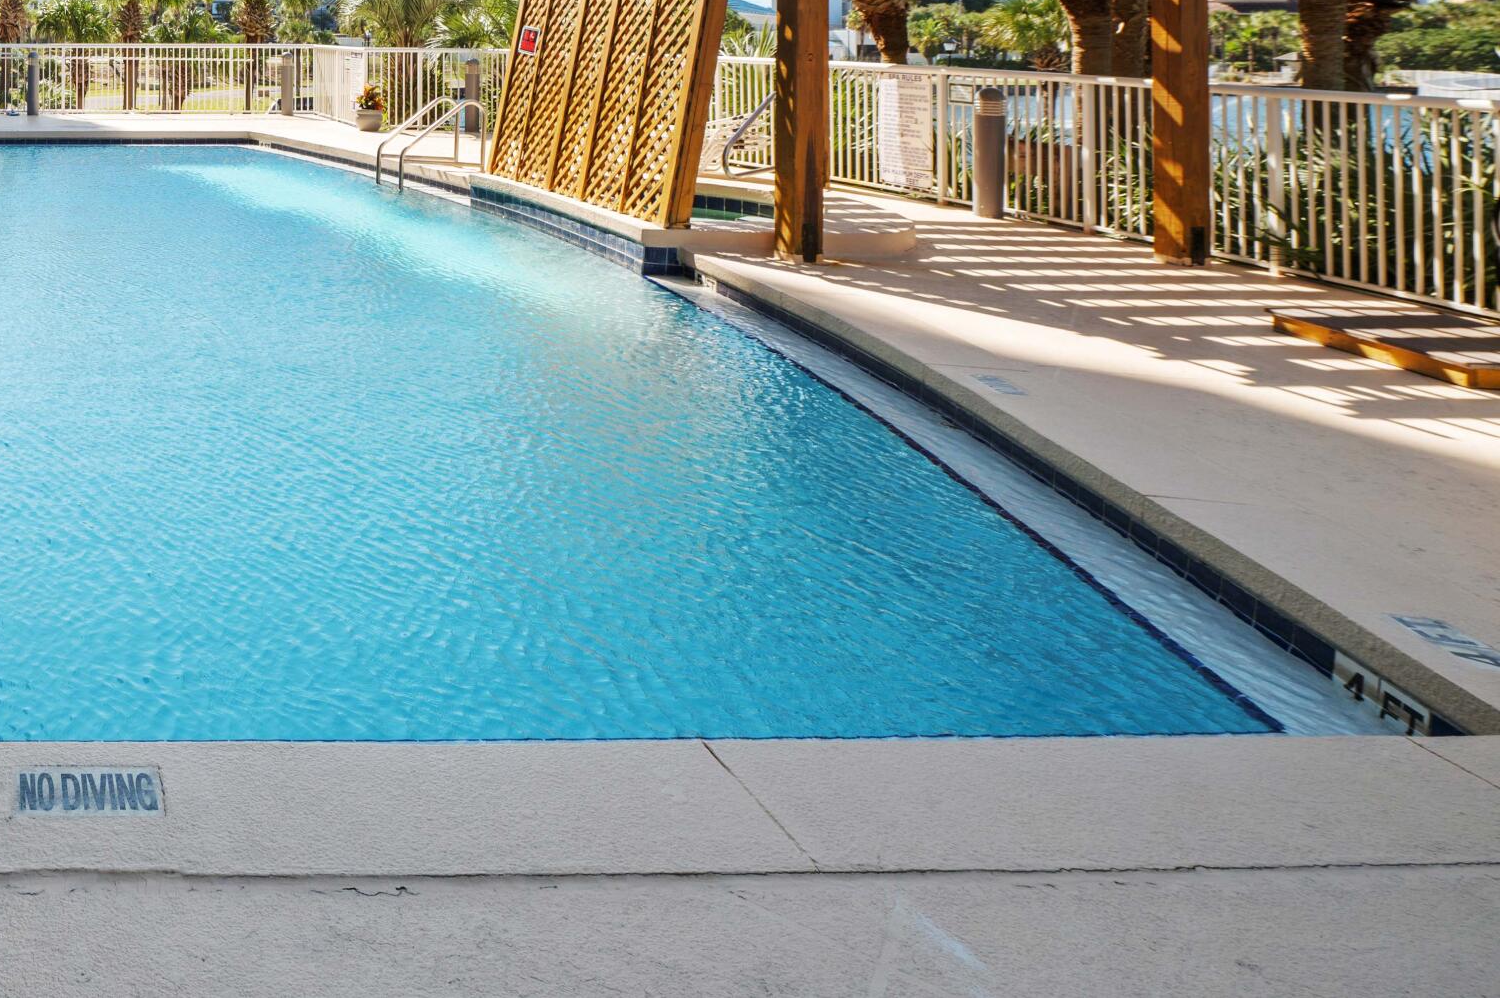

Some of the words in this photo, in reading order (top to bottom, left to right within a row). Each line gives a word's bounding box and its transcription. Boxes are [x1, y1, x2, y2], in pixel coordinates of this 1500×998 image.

[901, 74, 922, 82] RULES
[1380, 691, 1425, 735] FT
[19, 773, 55, 811] NO
[60, 772, 159, 811] DIVING
